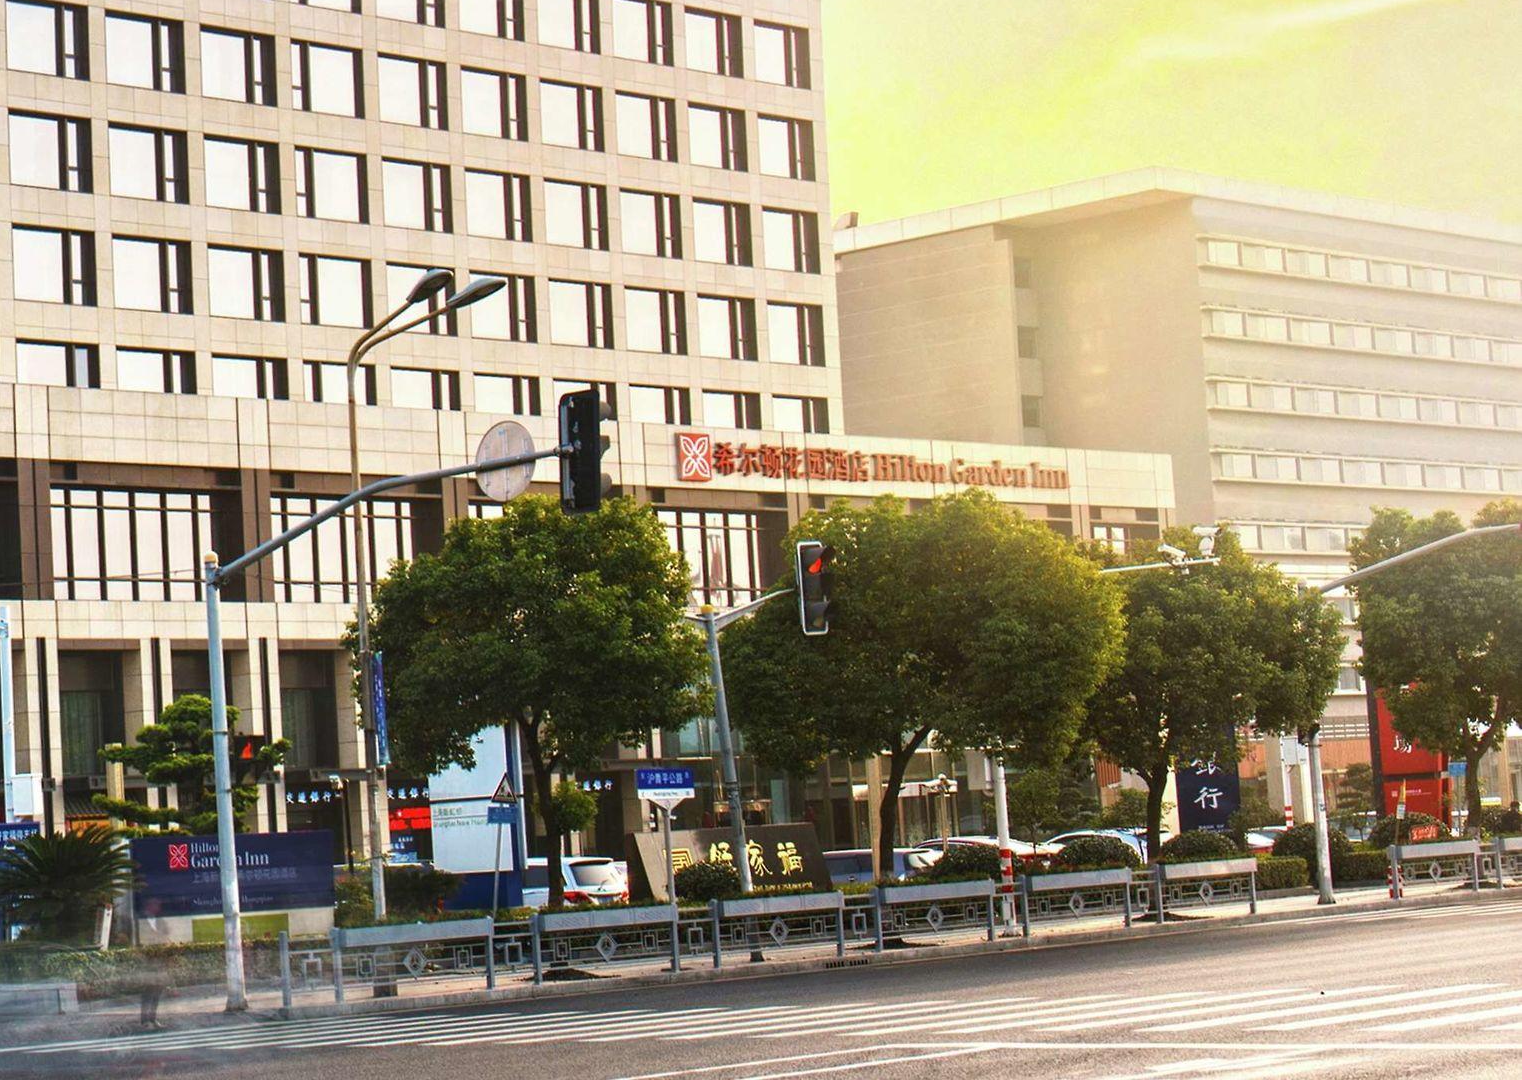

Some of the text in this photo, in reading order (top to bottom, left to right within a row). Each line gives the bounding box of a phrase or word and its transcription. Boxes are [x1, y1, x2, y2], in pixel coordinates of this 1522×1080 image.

[714, 441, 1069, 489] 希尔顿花园酒店 Hilton Garden Inn
[190, 842, 220, 854] Hilto
[191, 851, 270, 868] Garn Inn
